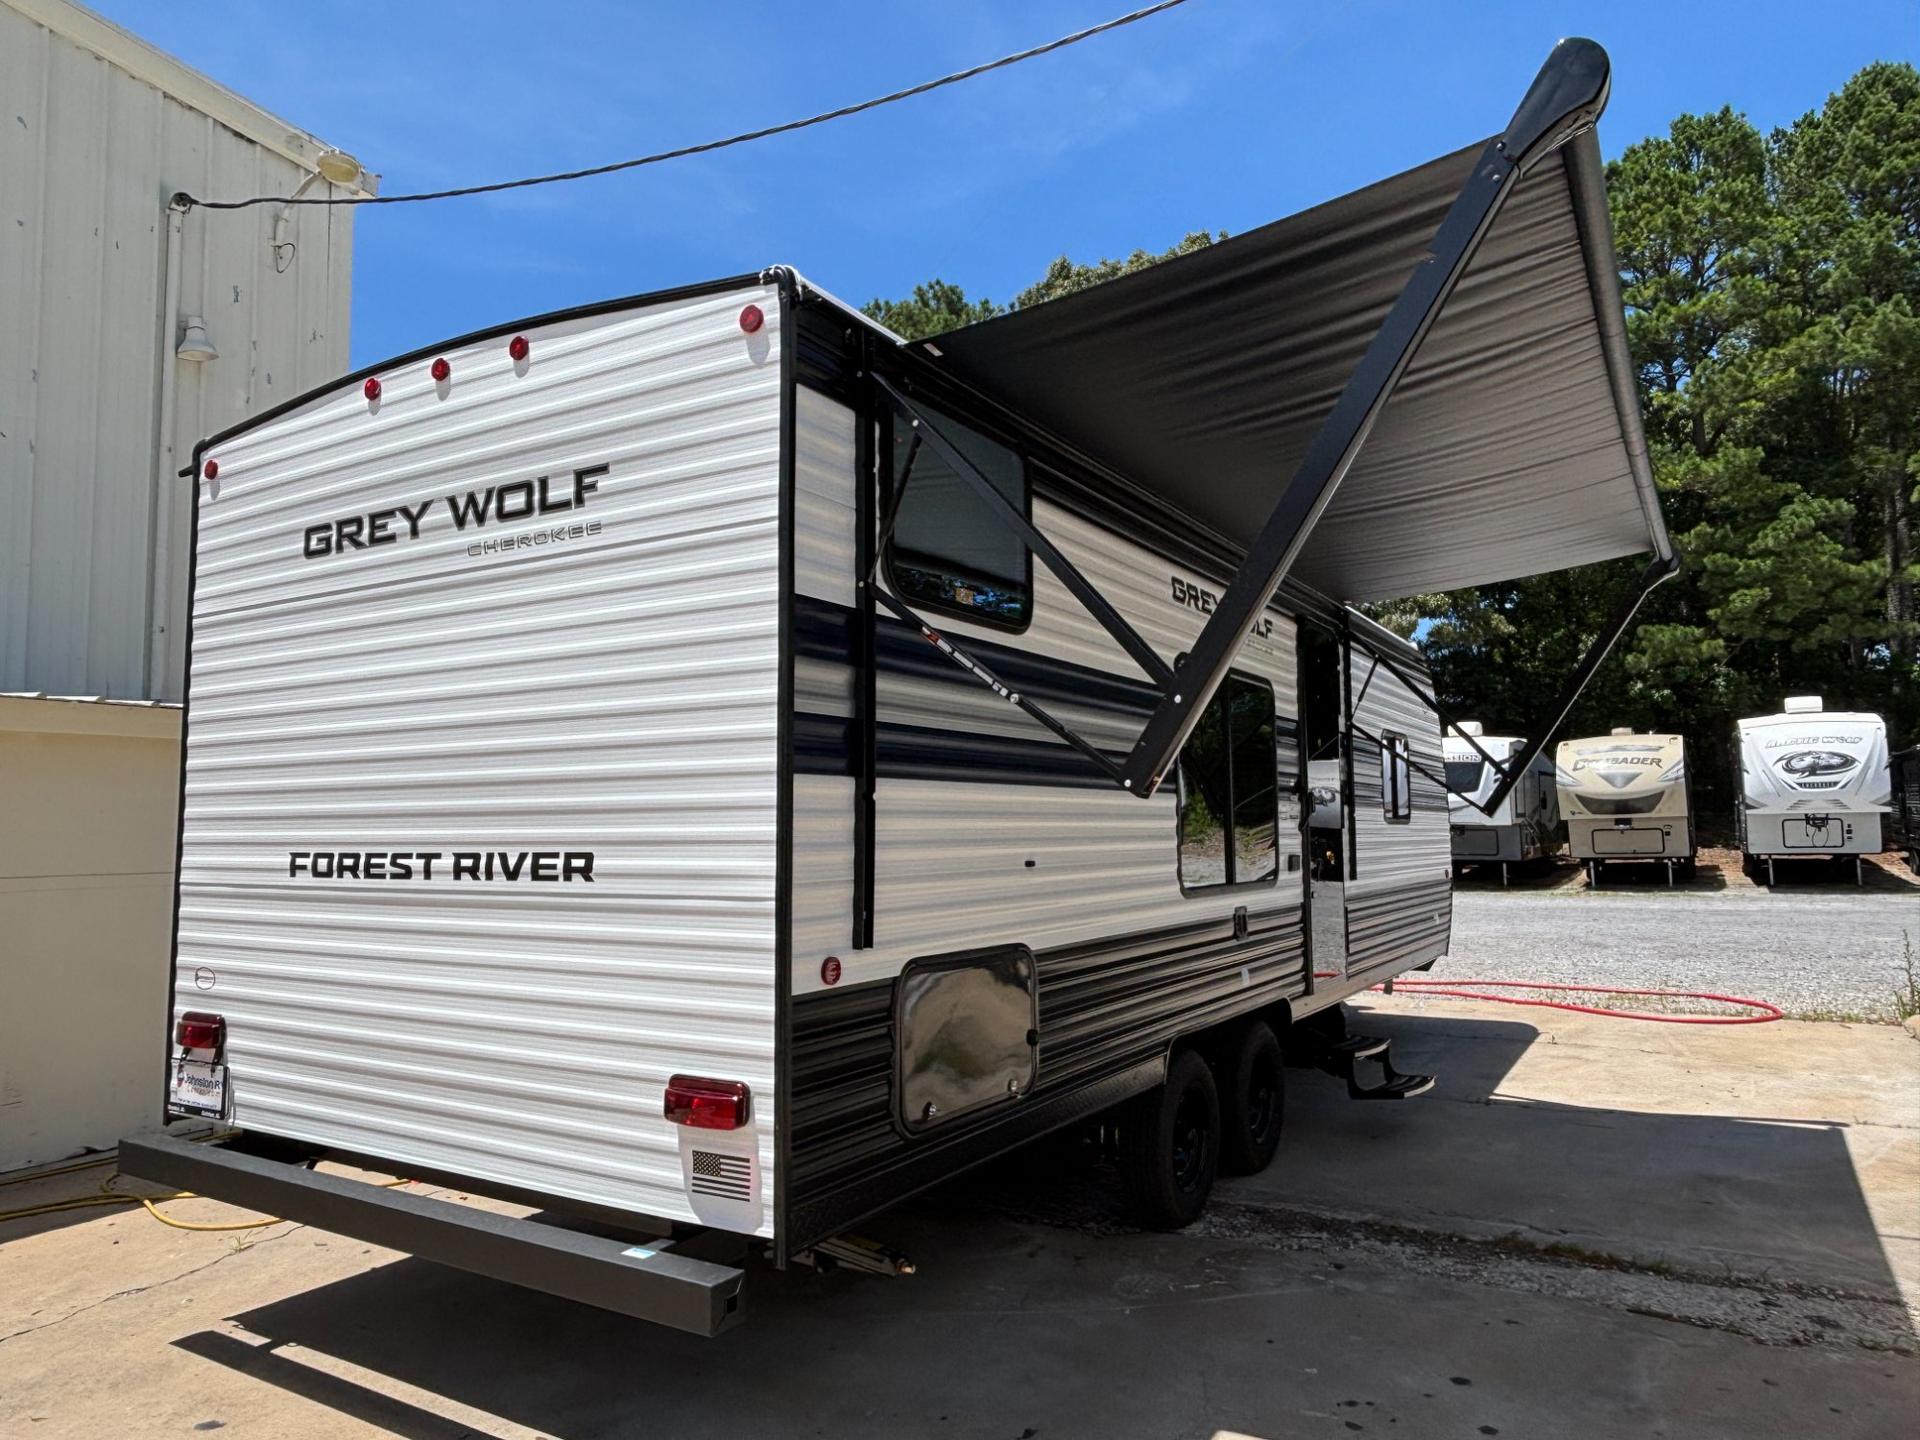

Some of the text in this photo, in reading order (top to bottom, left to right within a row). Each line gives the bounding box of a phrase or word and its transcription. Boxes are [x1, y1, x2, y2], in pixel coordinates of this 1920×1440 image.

[303, 462, 610, 560] GREY WOLF
[467, 521, 602, 557] CHEROKEE
[1572, 757, 1663, 772] CSADER
[289, 852, 595, 882] FOREST RIVER
